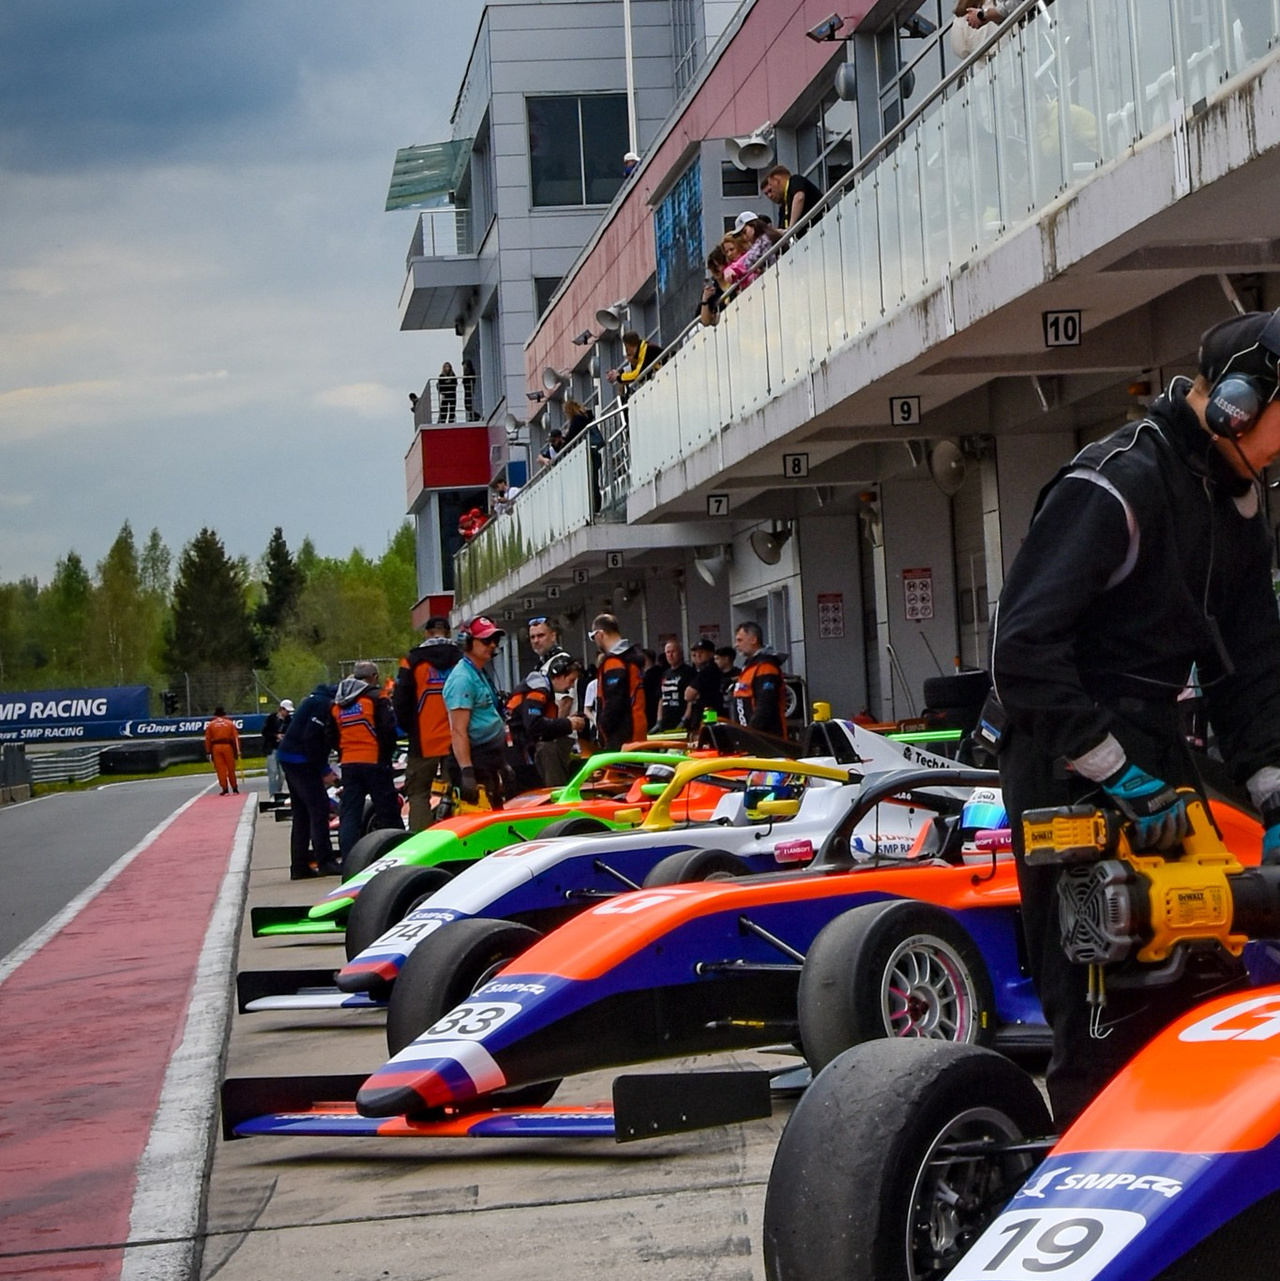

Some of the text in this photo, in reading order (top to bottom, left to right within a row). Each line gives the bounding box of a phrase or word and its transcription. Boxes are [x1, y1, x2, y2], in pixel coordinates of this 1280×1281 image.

[1048, 316, 1077, 342] 10
[900, 401, 912, 421] 9
[791, 458, 801, 474] 8
[714, 499, 722, 513] 7
[611, 554, 619, 566] 6
[578, 572, 585, 582] 5
[551, 588, 557, 597] 4
[0, 698, 107, 719] MP RACING
[20, 729, 43, 738] SMP
[44, 727, 84, 738] RACING
[179, 722, 202, 731] SMP
[379, 923, 430, 943] 74
[427, 1007, 505, 1035] 33
[982, 1218, 1104, 1272] 19
